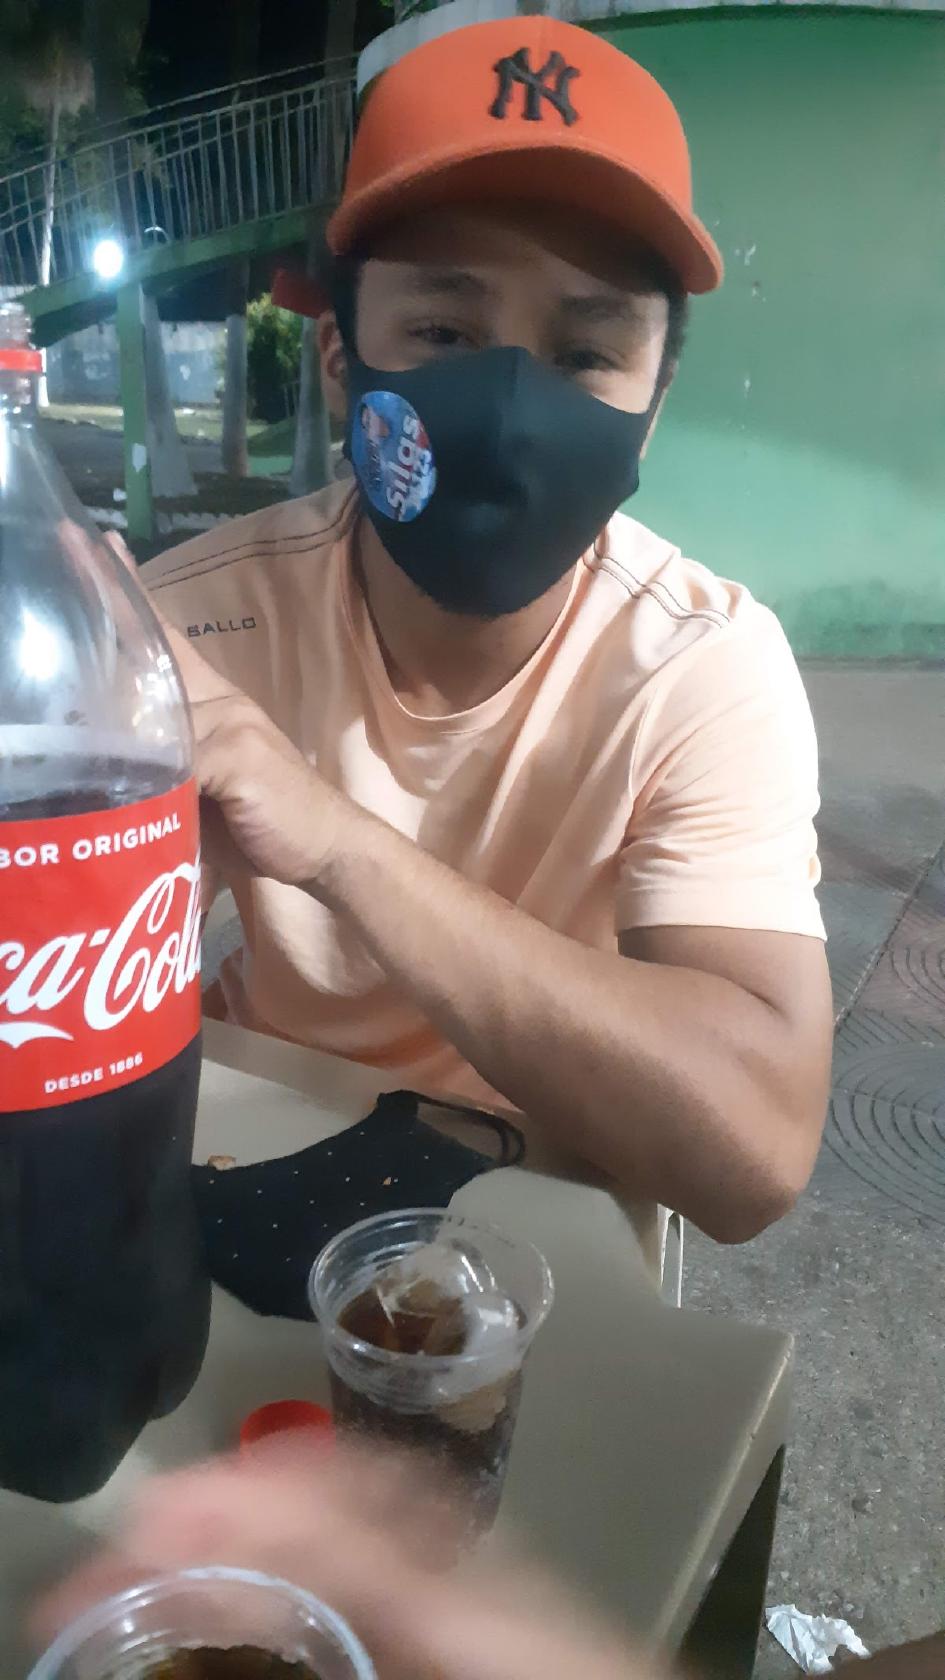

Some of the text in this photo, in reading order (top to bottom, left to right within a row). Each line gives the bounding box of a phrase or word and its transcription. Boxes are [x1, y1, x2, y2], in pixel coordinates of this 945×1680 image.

[488, 47, 580, 126] NY
[72, 812, 181, 860] ORIGINAL
[44, 1052, 143, 1093] DESDE 1886
